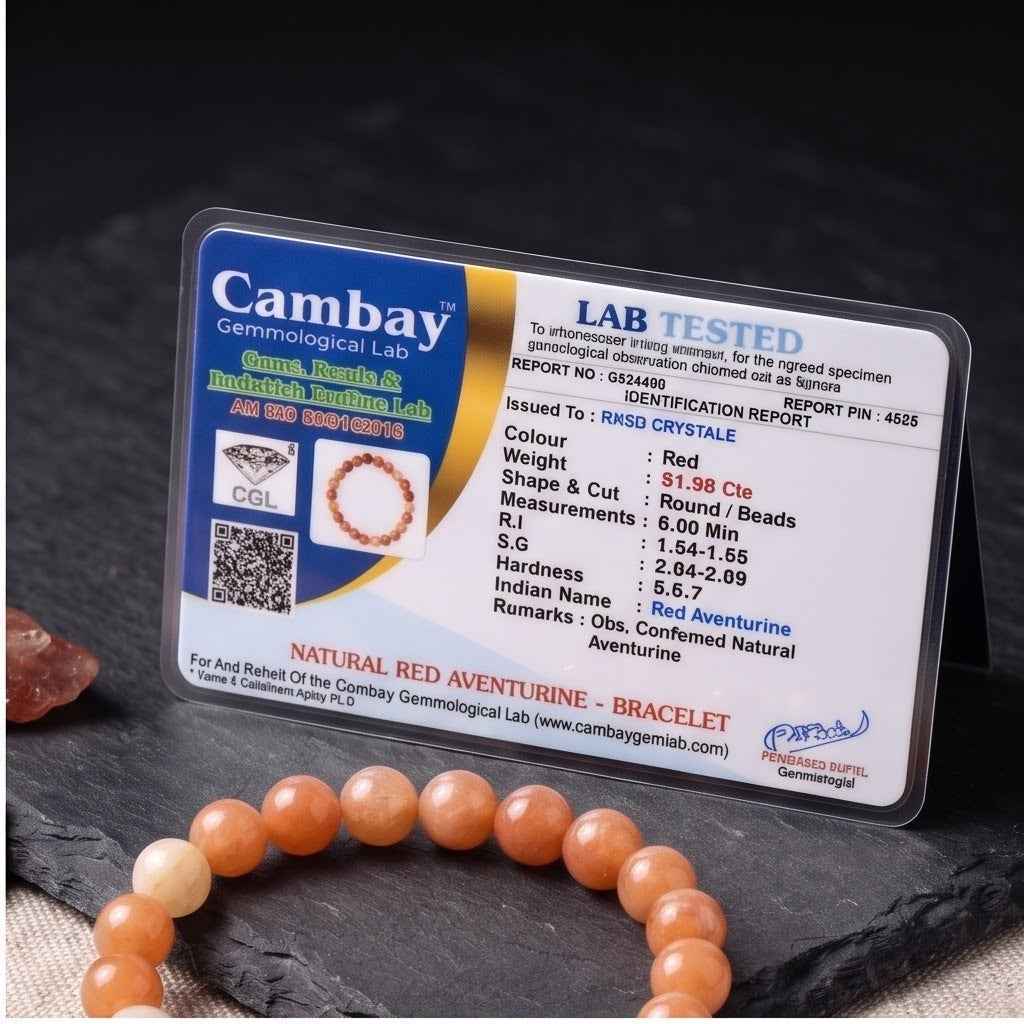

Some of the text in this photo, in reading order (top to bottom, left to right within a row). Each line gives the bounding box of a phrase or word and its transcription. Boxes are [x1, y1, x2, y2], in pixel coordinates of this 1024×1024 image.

[212, 270, 450, 352] Cambay
[576, 300, 647, 332] LAB
[660, 311, 803, 353] TESTED
[217, 317, 408, 359] Gemmological Lab
[530, 321, 545, 334] To
[732, 350, 749, 363] for
[754, 354, 774, 367] the
[828, 367, 891, 384] specimen
[511, 357, 570, 375] REPORT
[574, 366, 595, 379] NO
[783, 397, 843, 416] REPORT
[848, 406, 871, 420] PIN
[776, 375, 791, 386] as
[506, 396, 560, 416] Issued
[565, 405, 584, 420] To
[624, 390, 811, 427] IDENTIFICATION REPORT
[503, 446, 566, 471] Weight
[504, 425, 698, 469] Colour Red
[232, 486, 277, 509] CGL
[500, 490, 738, 541] Measurements 6.00 Min
[502, 469, 796, 528] Shape & Cut Round Beads
[497, 533, 528, 551] S.G
[496, 554, 583, 582] Hardness
[493, 597, 573, 624] Rumarks
[732, 635, 795, 659] Natural
[495, 576, 791, 636] Indian Name Red Aventurine
[588, 635, 680, 662] Aventurine
[190, 653, 211, 667] For
[214, 658, 239, 673] And
[289, 670, 306, 684] Of
[309, 674, 331, 689] the
[399, 689, 501, 719] Gemmological
[505, 707, 529, 724] Lab
[291, 643, 388, 675] NATURAL
[396, 660, 440, 683] RED
[447, 670, 587, 708] AVENTURINE
[613, 696, 730, 732] BRACELET
